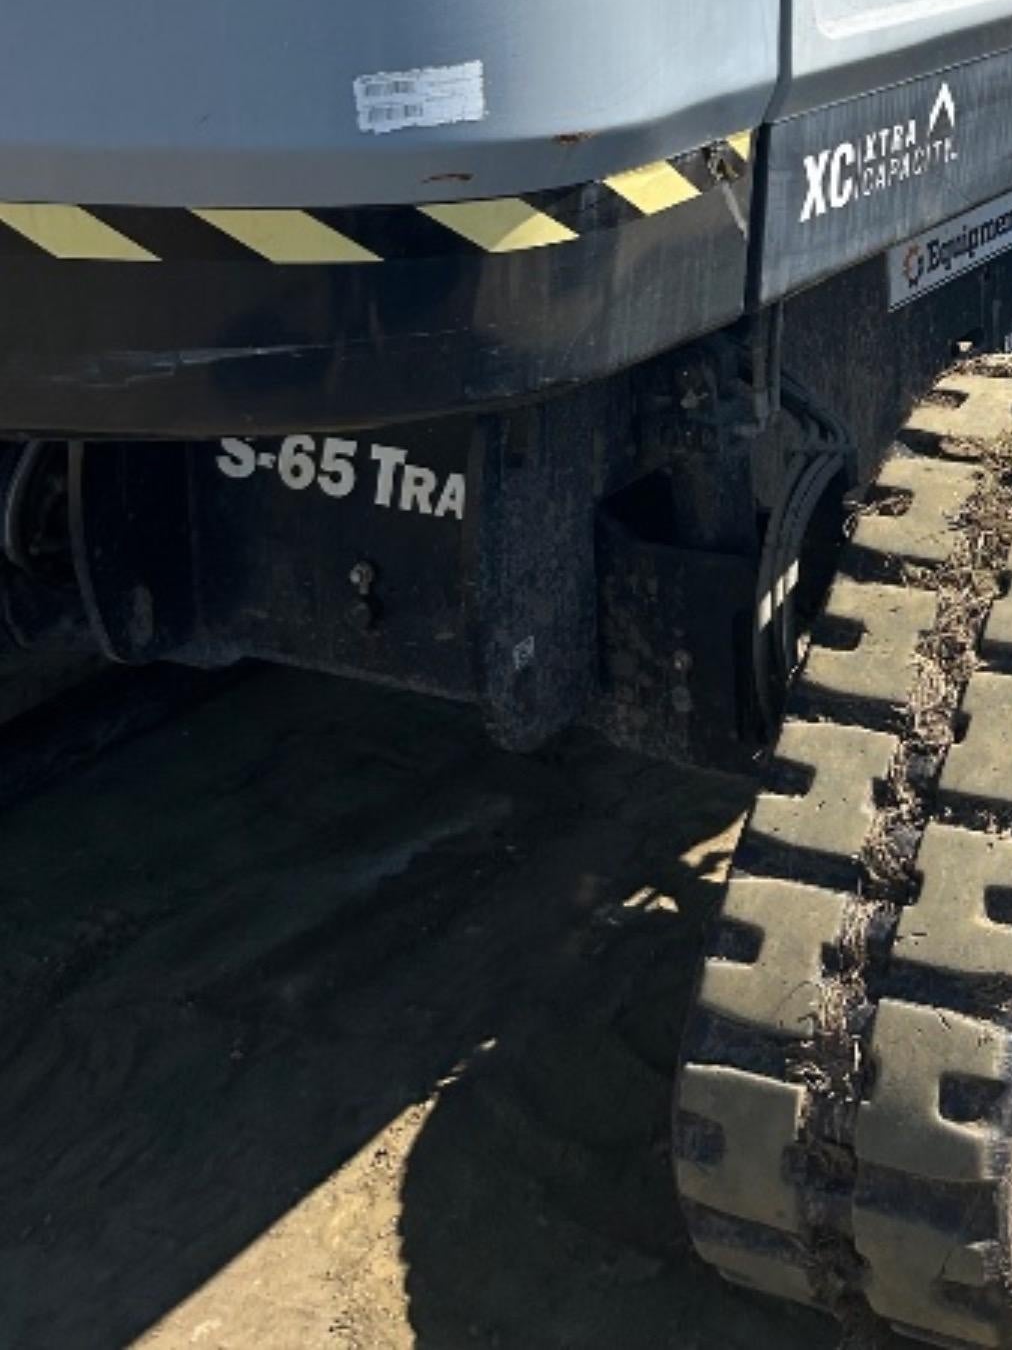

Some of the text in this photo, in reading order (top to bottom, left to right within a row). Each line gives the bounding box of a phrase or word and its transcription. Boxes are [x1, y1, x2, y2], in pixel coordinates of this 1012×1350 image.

[863, 119, 916, 163] XTRA
[800, 143, 855, 222] XC
[215, 434, 358, 498] S-65
